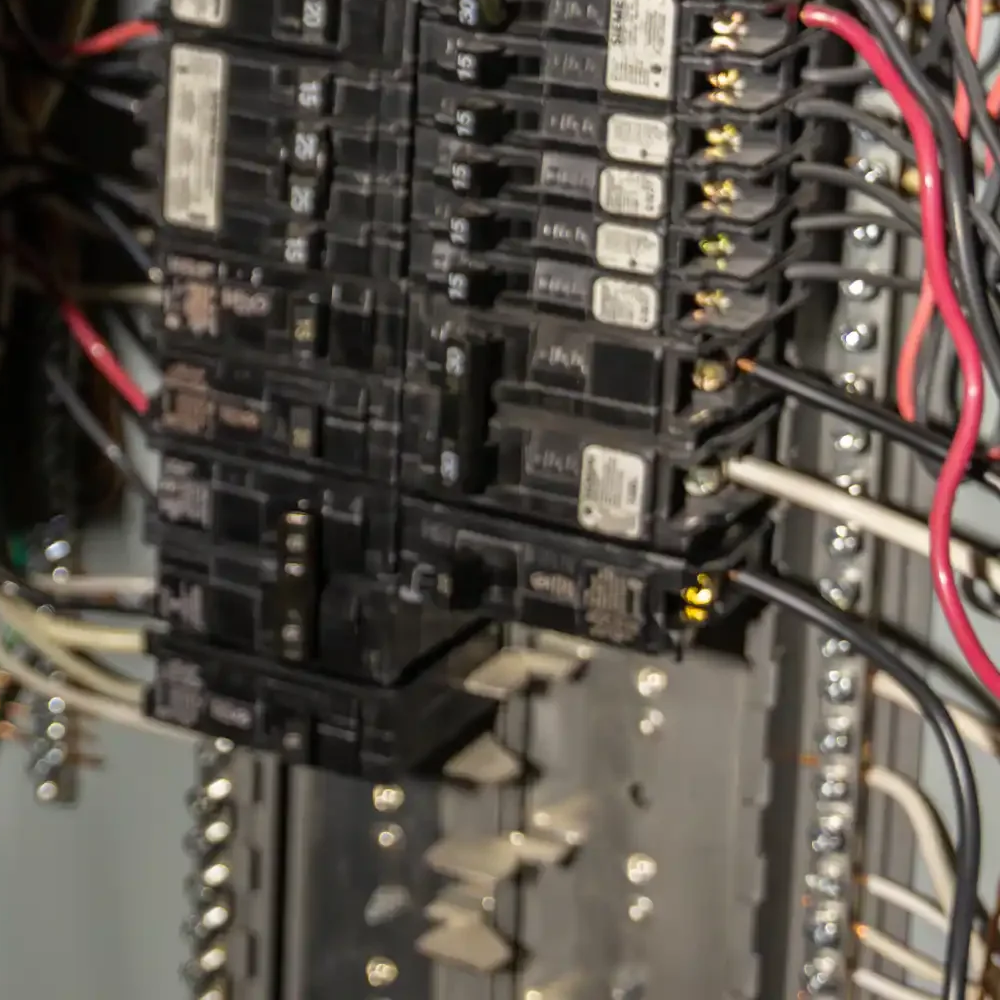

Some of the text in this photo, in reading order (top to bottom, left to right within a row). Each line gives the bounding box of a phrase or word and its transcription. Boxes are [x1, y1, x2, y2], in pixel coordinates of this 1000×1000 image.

[303, 0, 323, 28] 20
[457, 52, 477, 82] 15
[298, 80, 321, 109] 15
[455, 109, 476, 137] 15
[451, 163, 471, 191] 15
[450, 217, 470, 245] 15
[448, 272, 469, 300] 15
